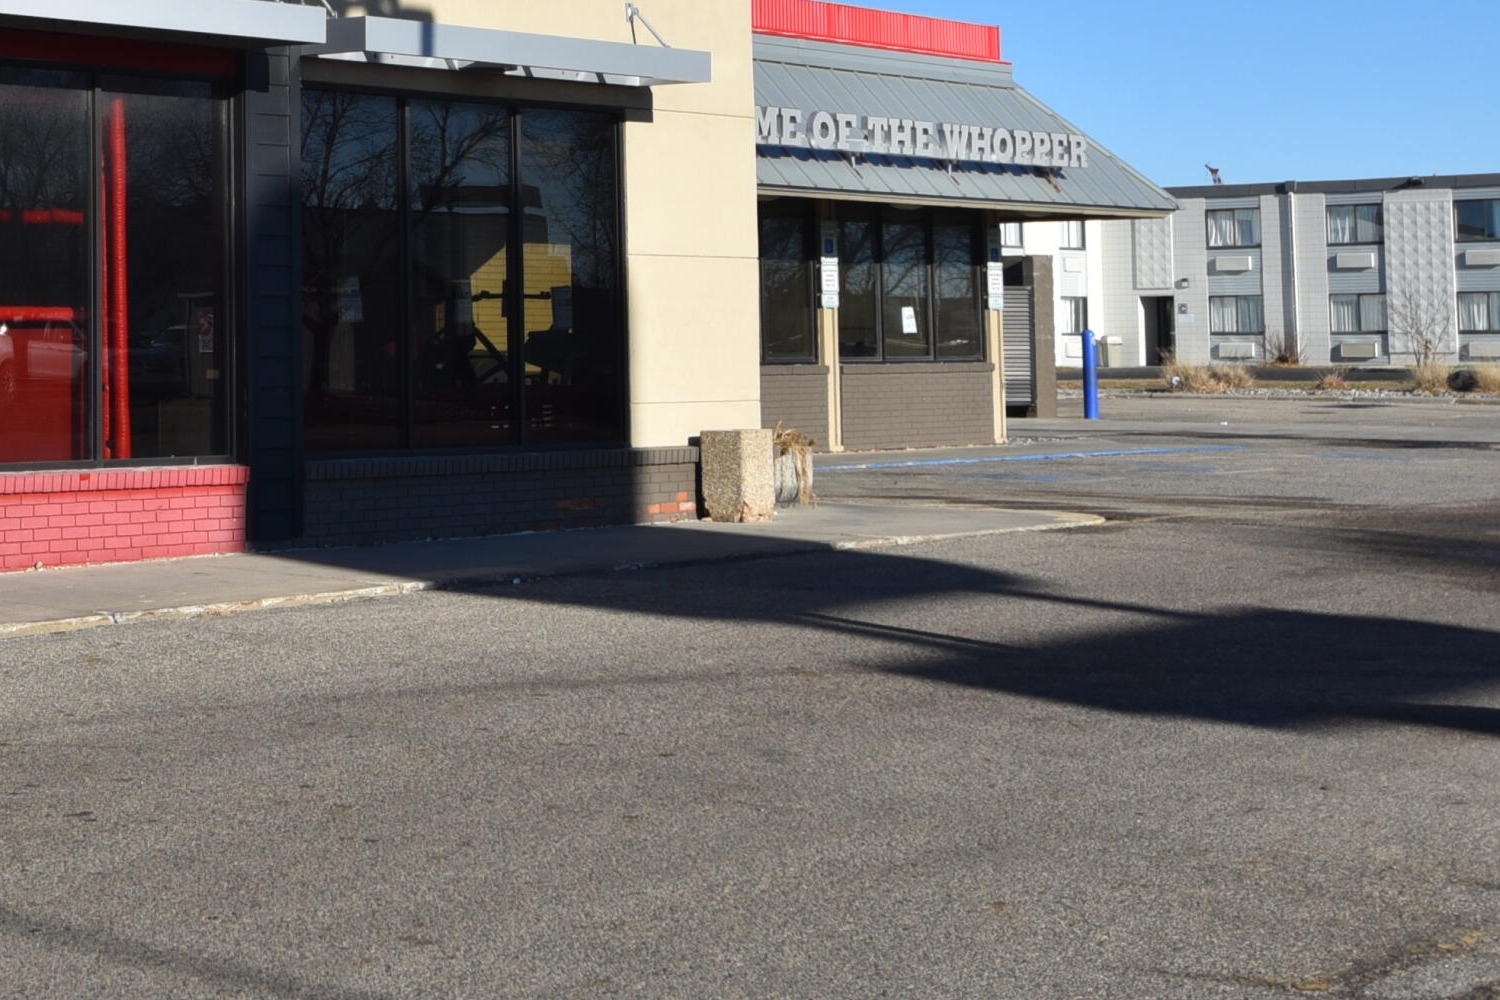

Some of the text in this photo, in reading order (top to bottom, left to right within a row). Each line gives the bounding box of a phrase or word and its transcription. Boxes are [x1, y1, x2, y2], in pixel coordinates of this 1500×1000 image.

[812, 110, 857, 151] OF
[867, 116, 933, 157] THE
[942, 123, 1088, 168] WHOPPER
